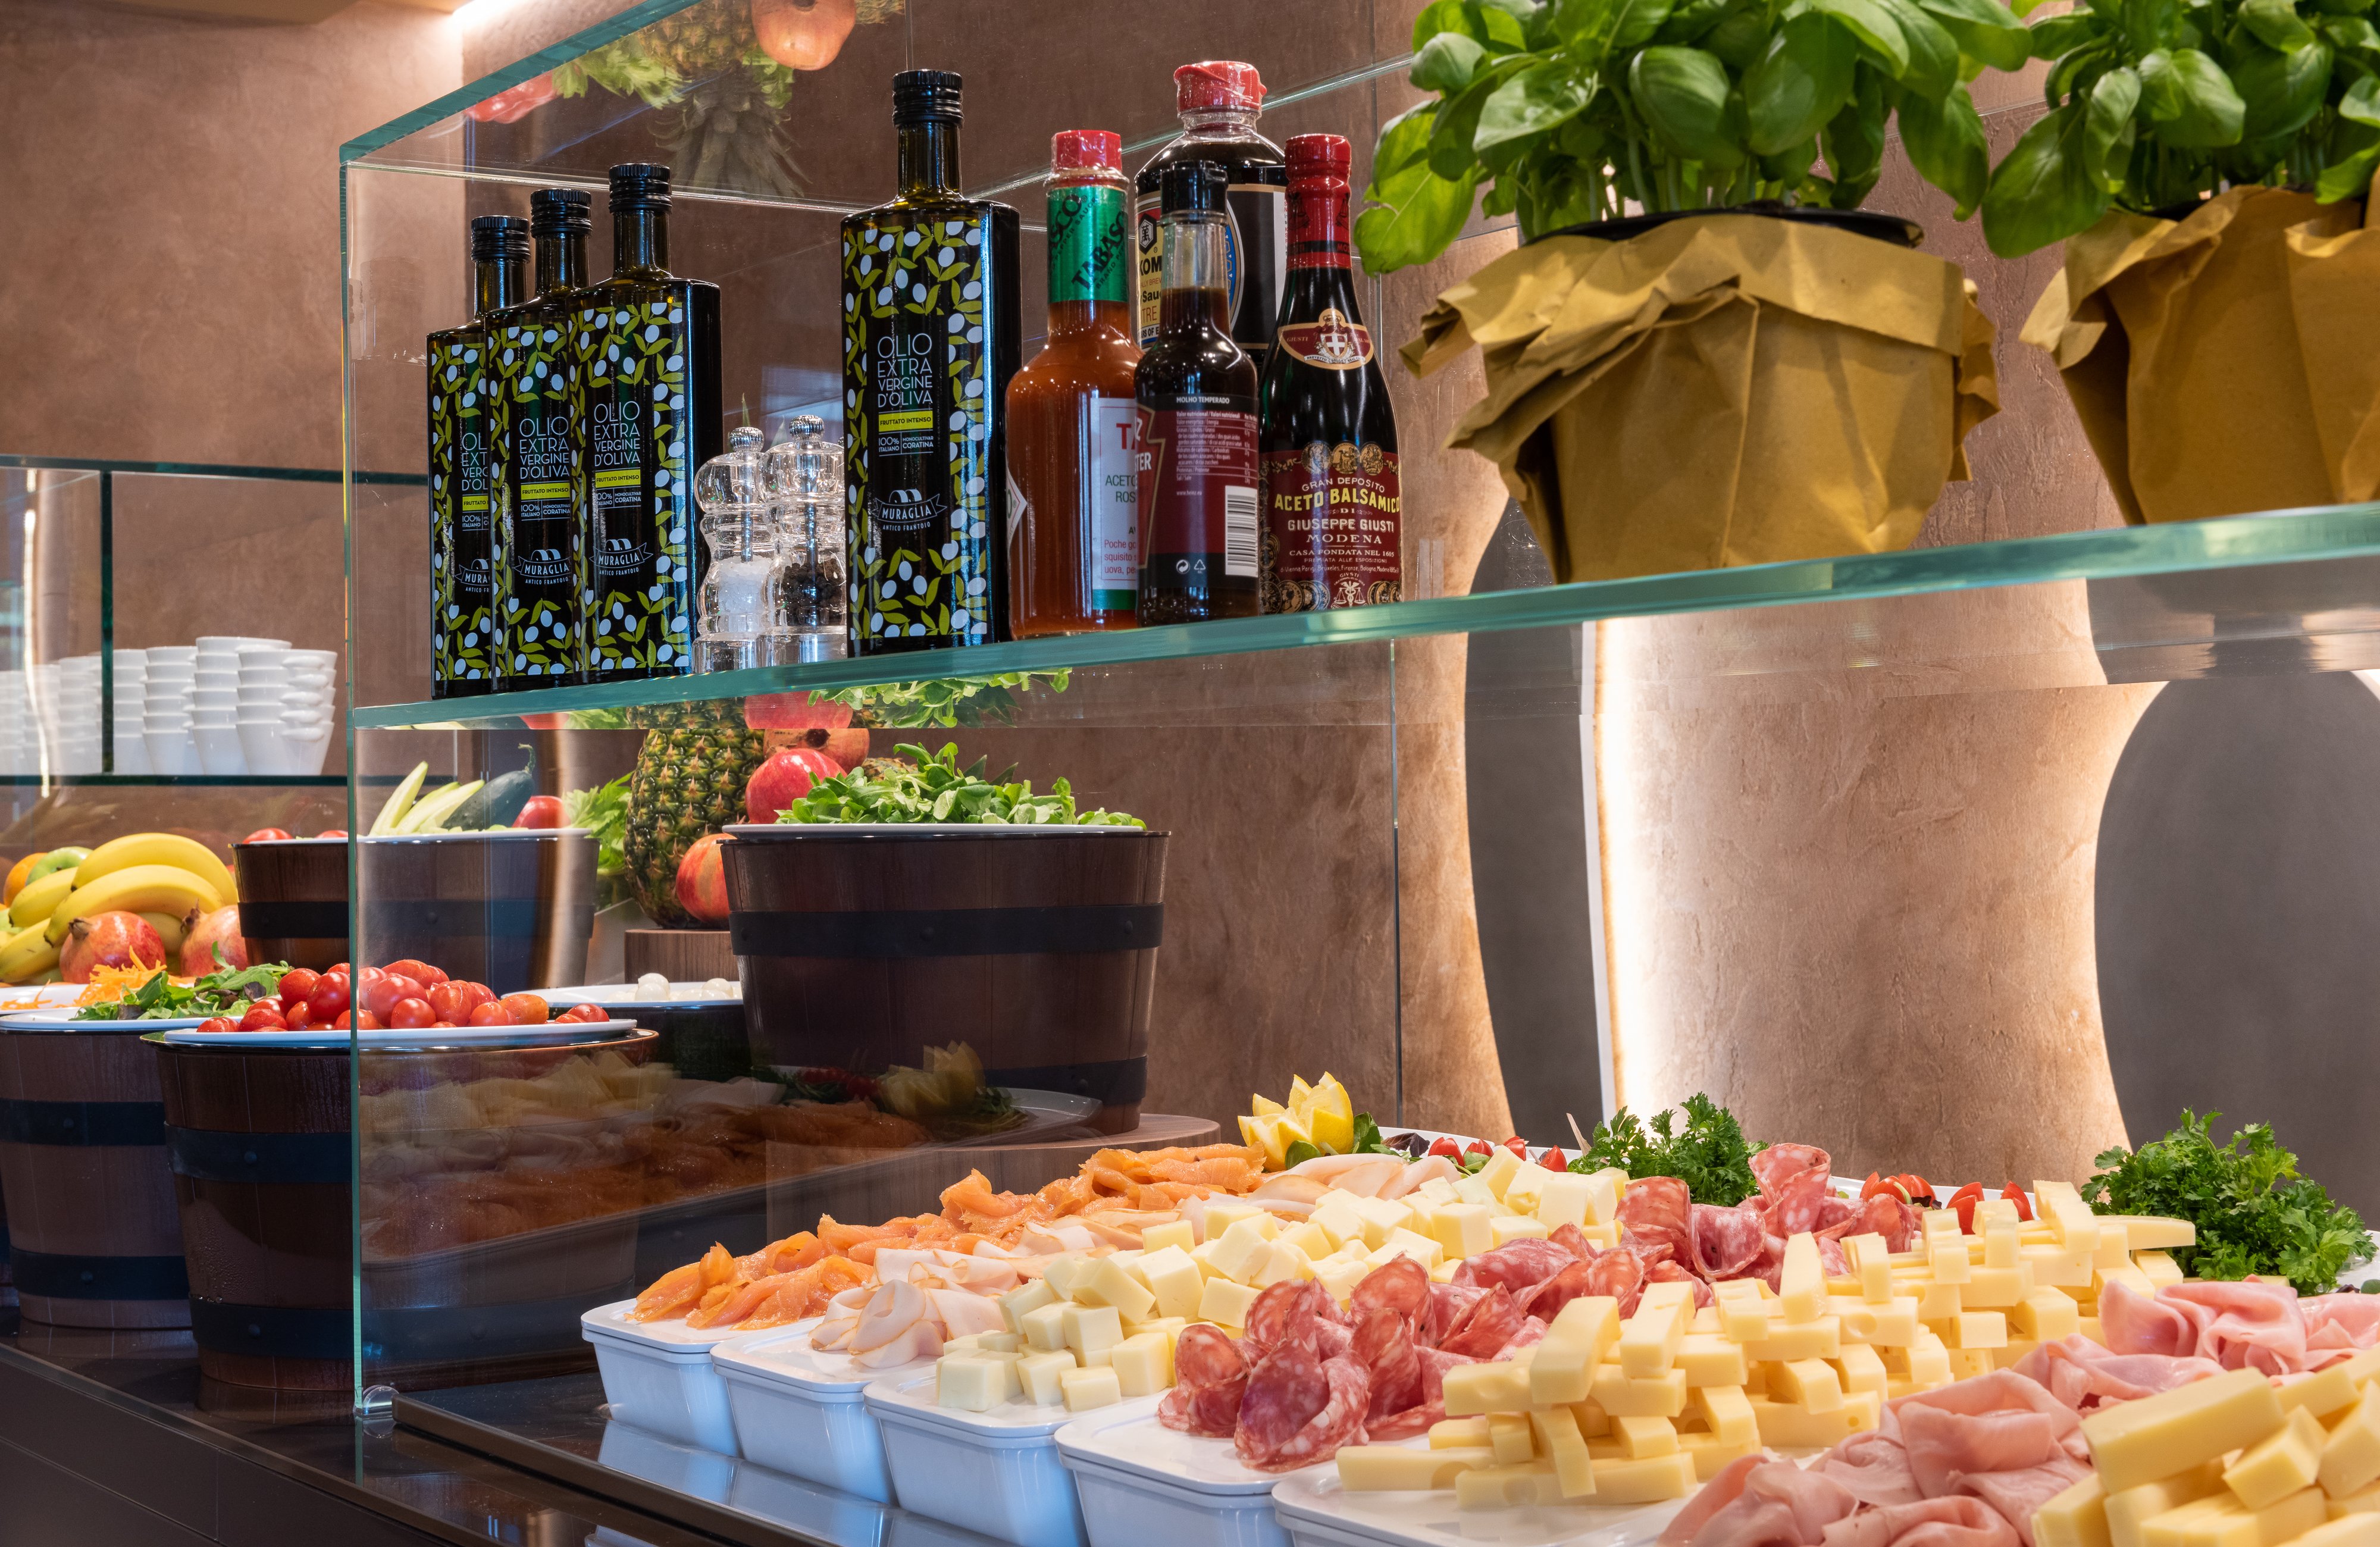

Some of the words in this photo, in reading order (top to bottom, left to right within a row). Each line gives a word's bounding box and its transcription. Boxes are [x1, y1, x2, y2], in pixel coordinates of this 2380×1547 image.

[1070, 211, 1125, 291] TABASC
[878, 333, 932, 358] OLIO
[878, 358, 933, 378] EXTRA
[878, 375, 933, 392] VERGINE
[878, 390, 933, 408] D'OLIVA
[594, 401, 640, 422] OLIO
[519, 416, 569, 437] OLIO
[594, 422, 640, 440] EXTRA
[462, 433, 487, 450] OL
[519, 437, 569, 453] EXTRA
[594, 438, 640, 452] VERGINE
[878, 437, 899, 446] 100%
[462, 452, 487, 466] EXT
[520, 453, 569, 465] VERGINE
[594, 451, 641, 466] D'OLIVA
[520, 465, 570, 479] D'OLIVA
[1302, 478, 1333, 492] GRAN
[1337, 477, 1385, 493] DEPOSITO
[1274, 491, 1324, 512] ACETO
[1330, 488, 1399, 513] BALSAMICO
[882, 505, 932, 520] MURAGLIA
[903, 521, 931, 531] FRANTOIO
[1288, 518, 1356, 531] GIUSEPPE
[1360, 519, 1395, 533] GIUSTI
[1104, 540, 1126, 549] Poche
[1306, 534, 1382, 544] MODENA
[599, 552, 640, 566] MURAGLIA
[1104, 553, 1133, 565] squisito
[525, 562, 569, 575] MURAGLIA
[616, 567, 639, 575] FRANTOIO
